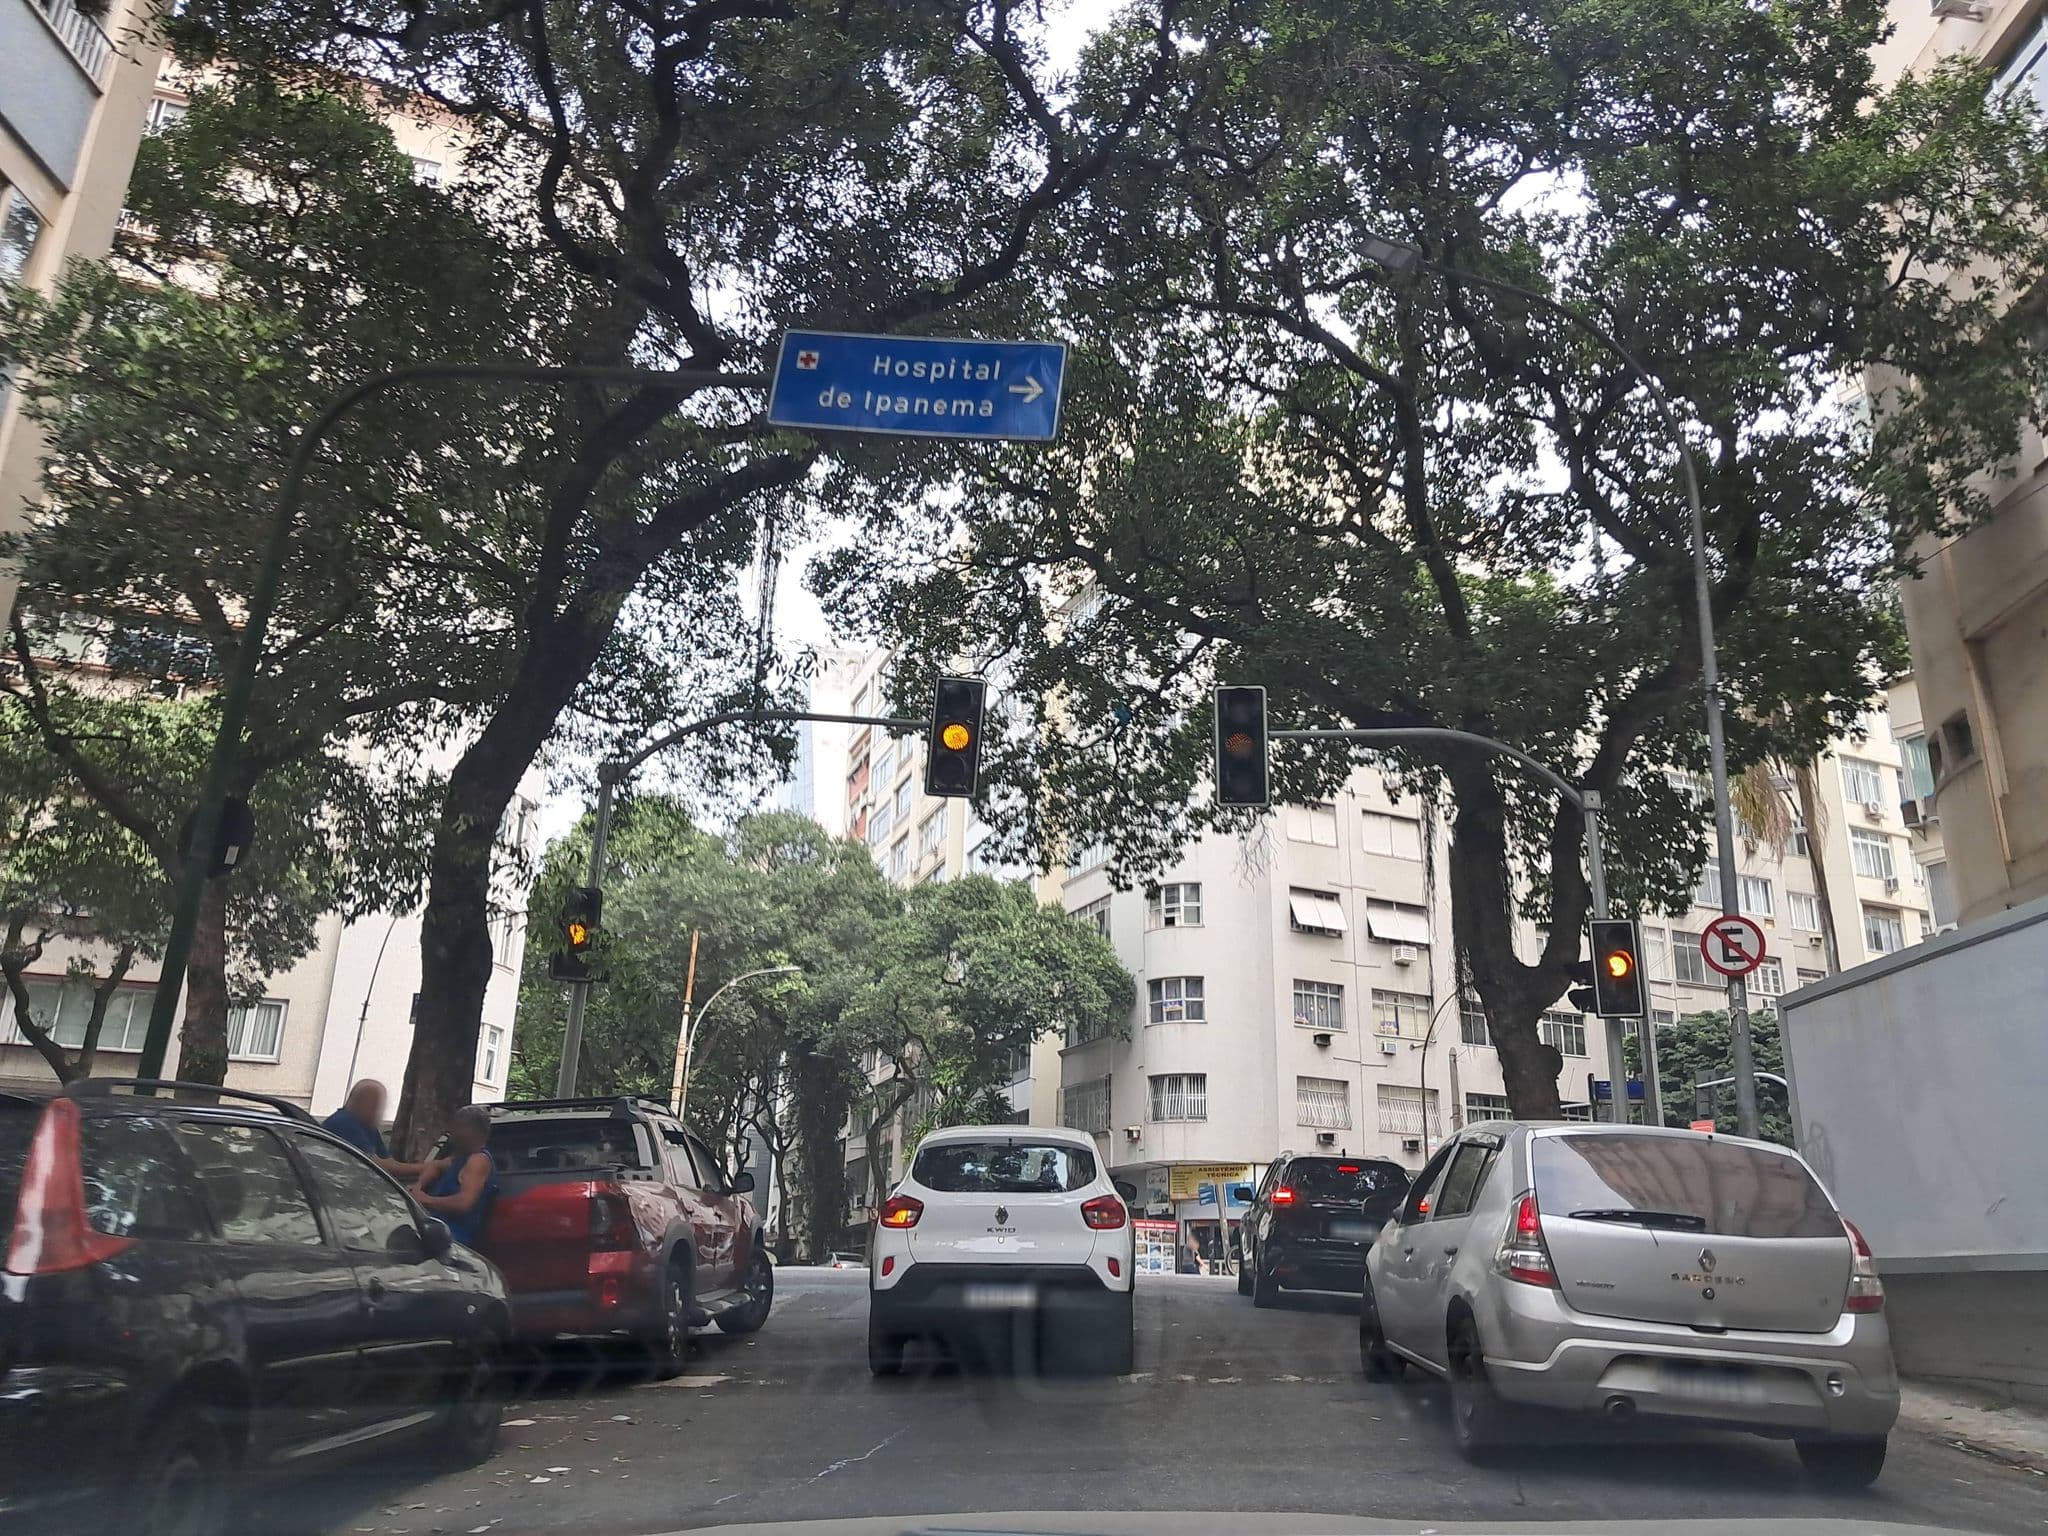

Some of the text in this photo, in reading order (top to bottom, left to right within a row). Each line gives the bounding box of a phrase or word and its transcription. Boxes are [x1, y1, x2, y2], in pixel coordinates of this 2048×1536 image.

[873, 355, 1000, 384] Hospital
[818, 385, 994, 417] de Ipanema
